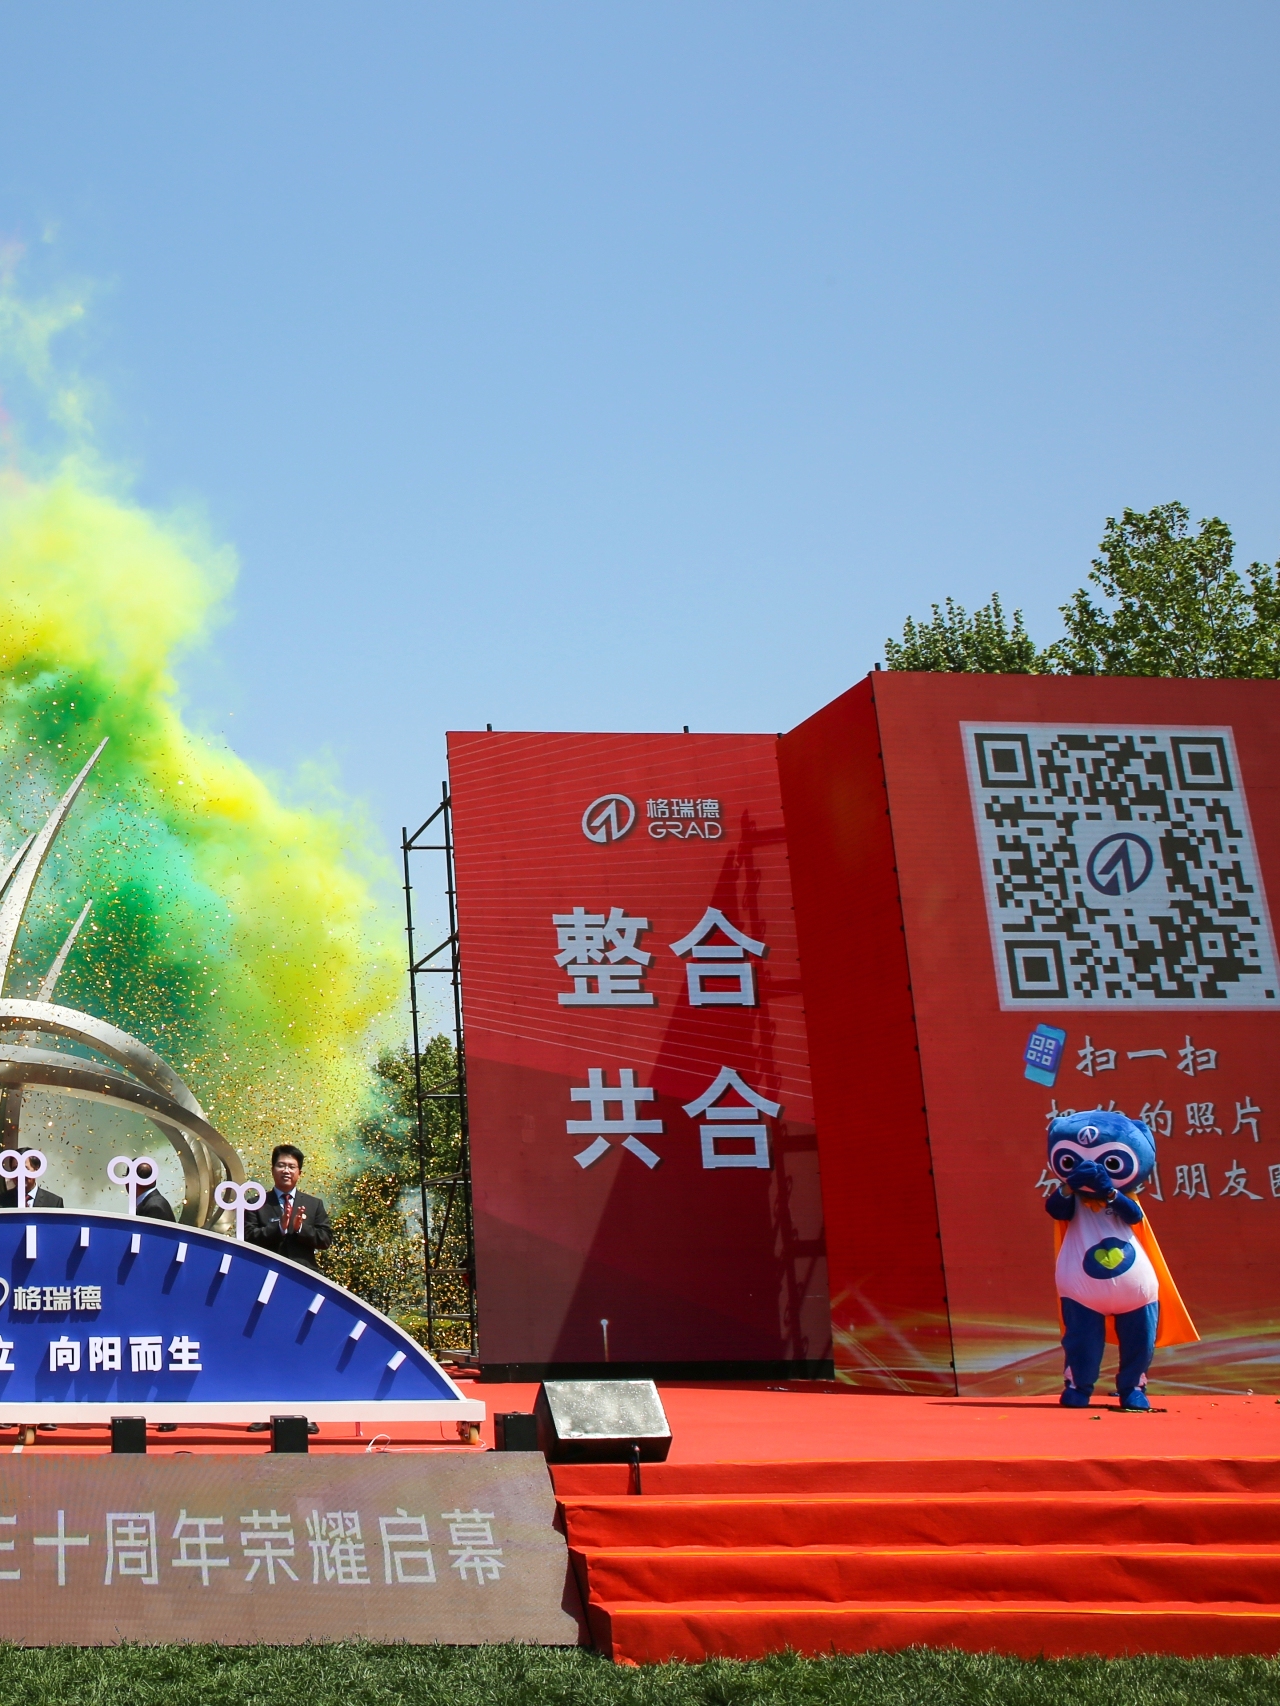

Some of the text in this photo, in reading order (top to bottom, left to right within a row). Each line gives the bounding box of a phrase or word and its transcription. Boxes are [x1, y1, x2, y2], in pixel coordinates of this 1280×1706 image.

[646, 798, 720, 819] 格瑞德
[647, 821, 723, 839] GRAD
[552, 905, 766, 1006] 整合
[1076, 1034, 1218, 1077] 扫一扫
[566, 1065, 781, 1169] 共合
[13, 1285, 102, 1312] 格瑞德
[49, 1335, 203, 1372] 向阳而生
